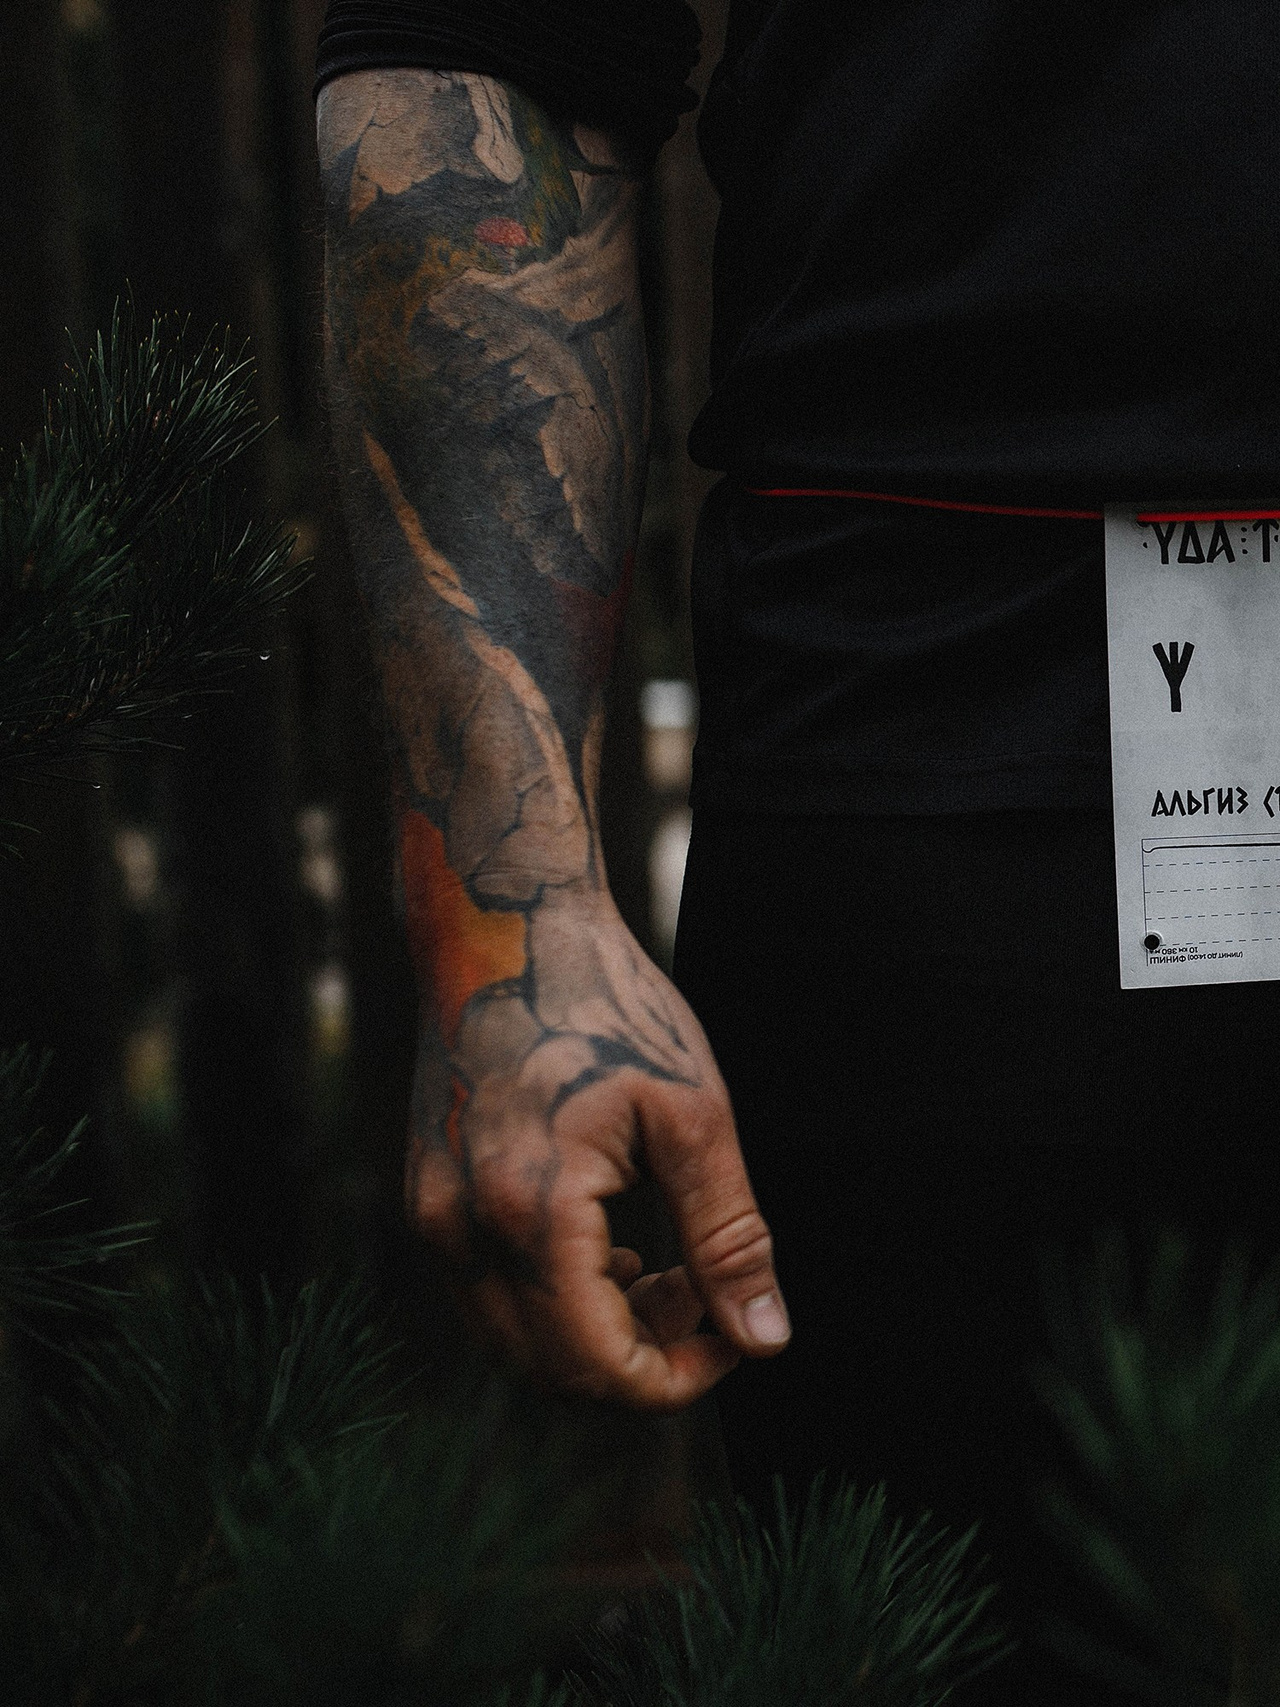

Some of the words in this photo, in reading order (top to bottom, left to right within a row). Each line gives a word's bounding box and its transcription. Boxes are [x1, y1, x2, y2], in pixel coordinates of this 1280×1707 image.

[1151, 786, 1249, 817] АЛЬГИЗ
[1150, 955, 1186, 964] ФИНИШ
[1207, 951, 1217, 960] ДО
